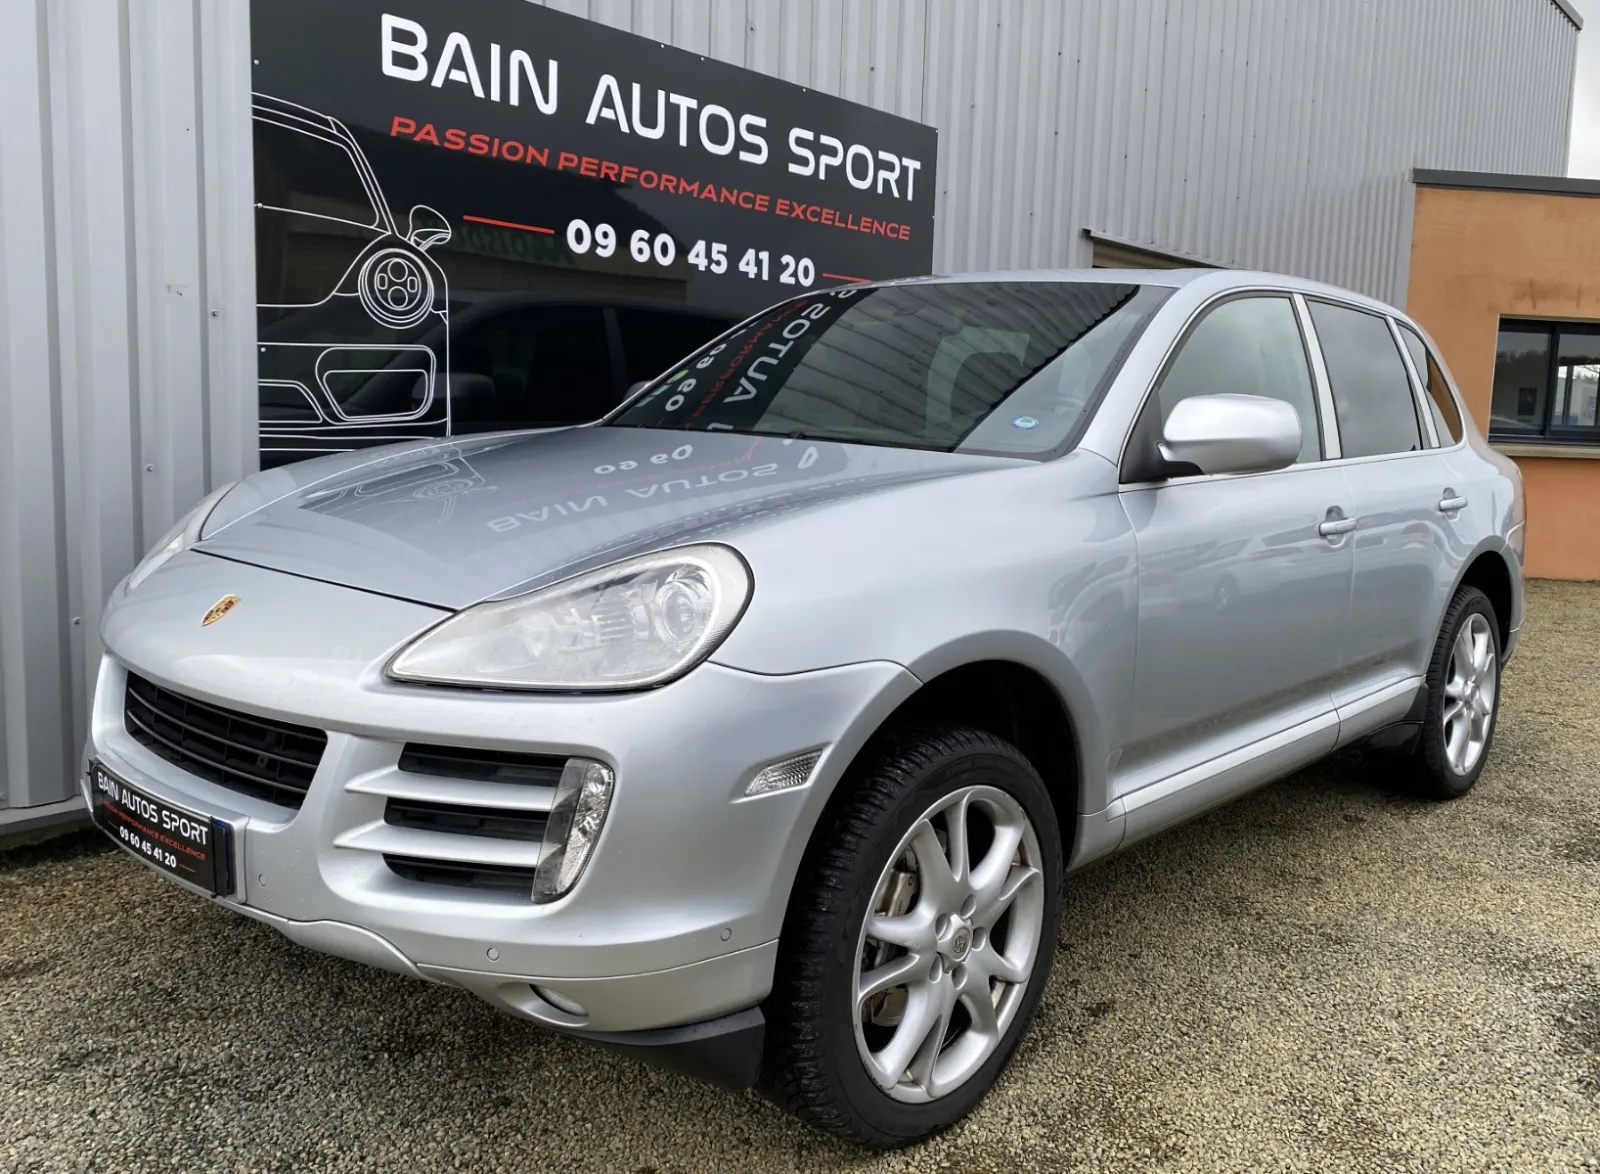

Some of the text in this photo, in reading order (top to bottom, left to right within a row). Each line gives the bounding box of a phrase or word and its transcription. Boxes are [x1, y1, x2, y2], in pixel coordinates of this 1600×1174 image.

[381, 13, 921, 201] BAIN AUTOS SPORT
[390, 116, 912, 241] PASSION PERFORMANCE EXCELLENCE
[566, 218, 617, 258] 09
[629, 229, 676, 266] 60
[687, 239, 729, 275] 45
[738, 248, 770, 281] 41
[779, 254, 815, 287] 20
[97, 771, 119, 801] BAIN
[122, 788, 158, 823] AUTOS
[161, 810, 208, 845] SPORT
[119, 825, 177, 868] 09 60 45 41 20
[160, 833, 206, 861] EXCELLENCE
